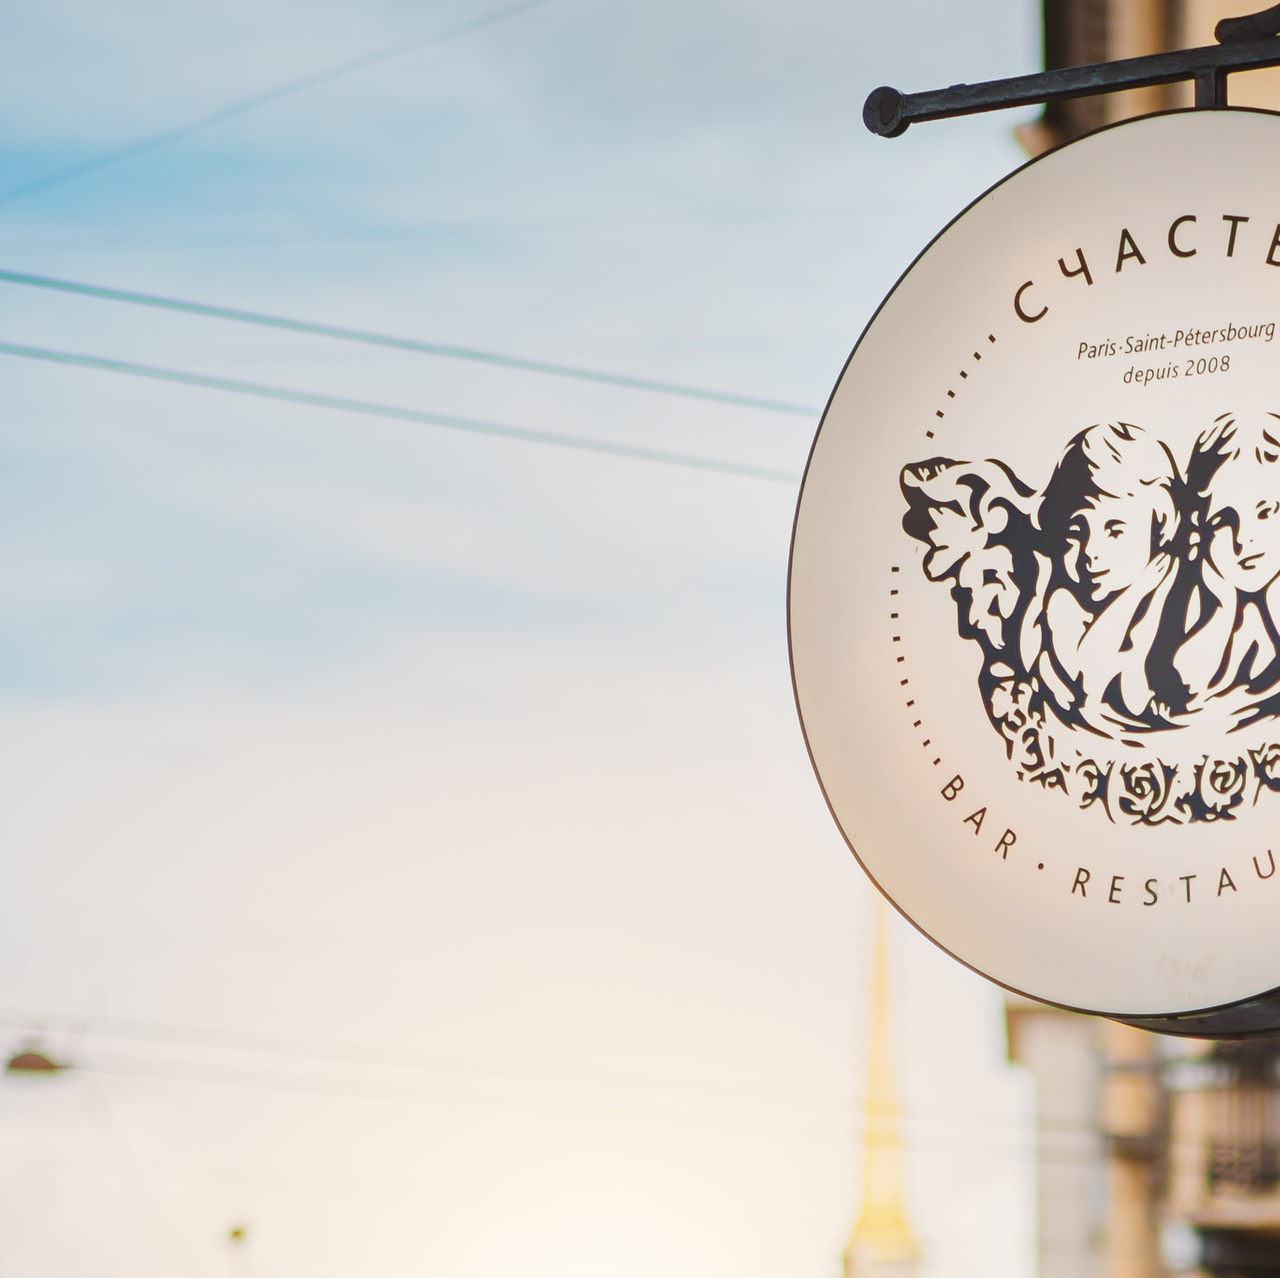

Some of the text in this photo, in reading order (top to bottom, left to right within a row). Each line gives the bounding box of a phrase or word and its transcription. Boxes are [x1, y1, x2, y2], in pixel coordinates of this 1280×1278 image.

[1122, 355, 1231, 387] depuis 2008
[940, 773, 1017, 861] BAR
